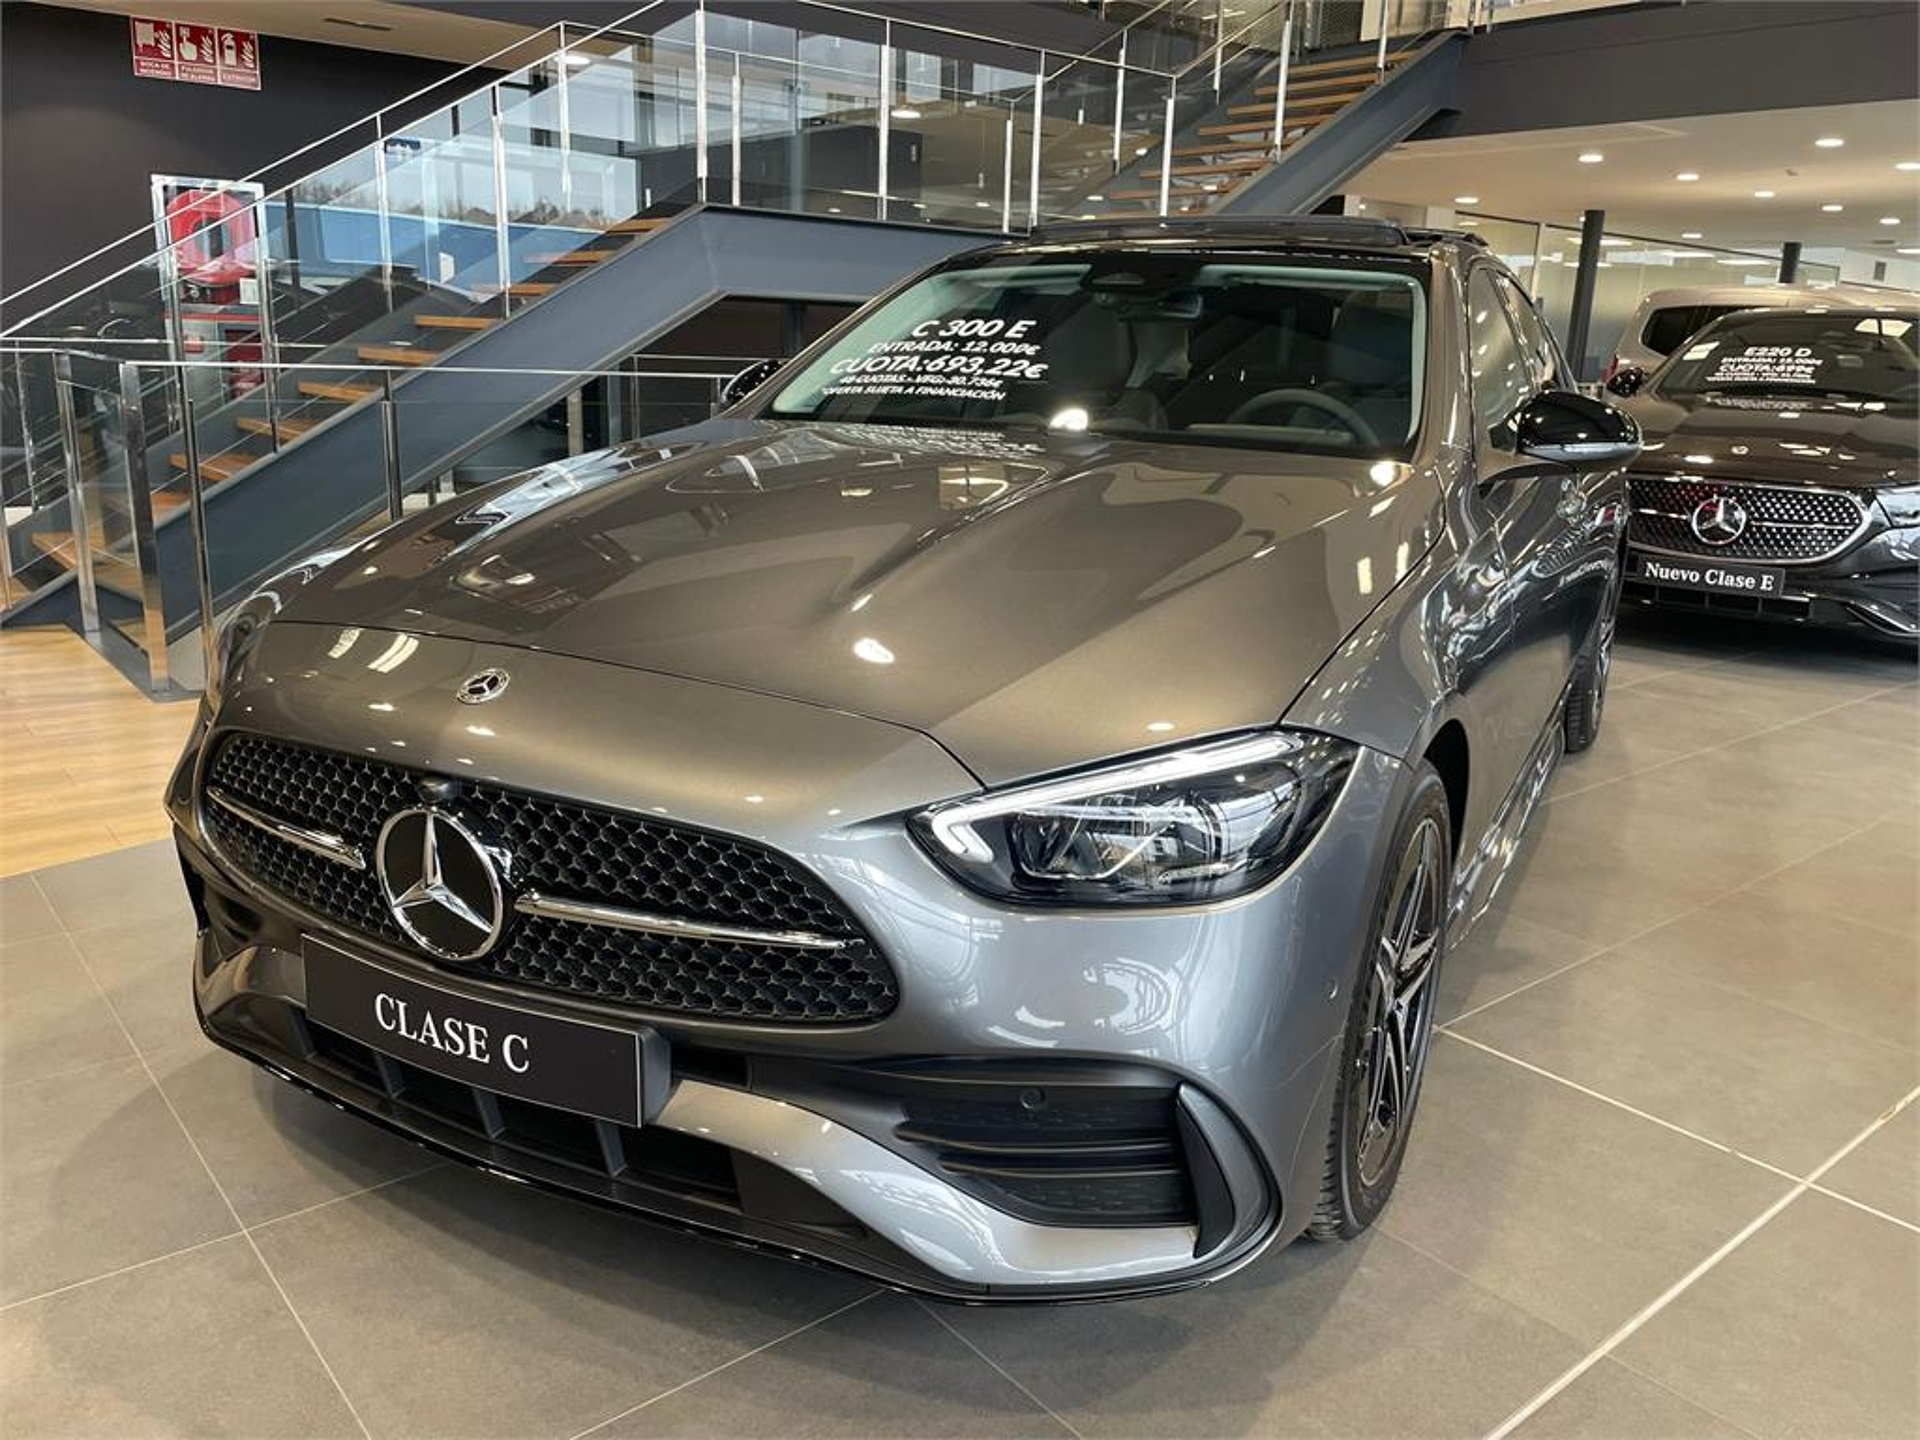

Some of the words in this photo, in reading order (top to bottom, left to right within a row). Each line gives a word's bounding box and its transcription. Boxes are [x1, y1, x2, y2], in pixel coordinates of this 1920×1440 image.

[911, 320, 940, 338] C
[938, 319, 1005, 338] 300
[1004, 320, 1037, 338] E
[868, 341, 959, 354] ENTRADA:
[961, 341, 1041, 355] 12.000€
[1744, 347, 1792, 357] E220
[1795, 347, 1812, 357] D
[830, 355, 1049, 378] CUOTA:693,22€
[1645, 562, 1700, 583] Nuevo
[1705, 569, 1756, 589] Clase
[1760, 574, 1775, 591] E
[375, 993, 490, 1064] CLASE
[502, 1034, 530, 1073] C
